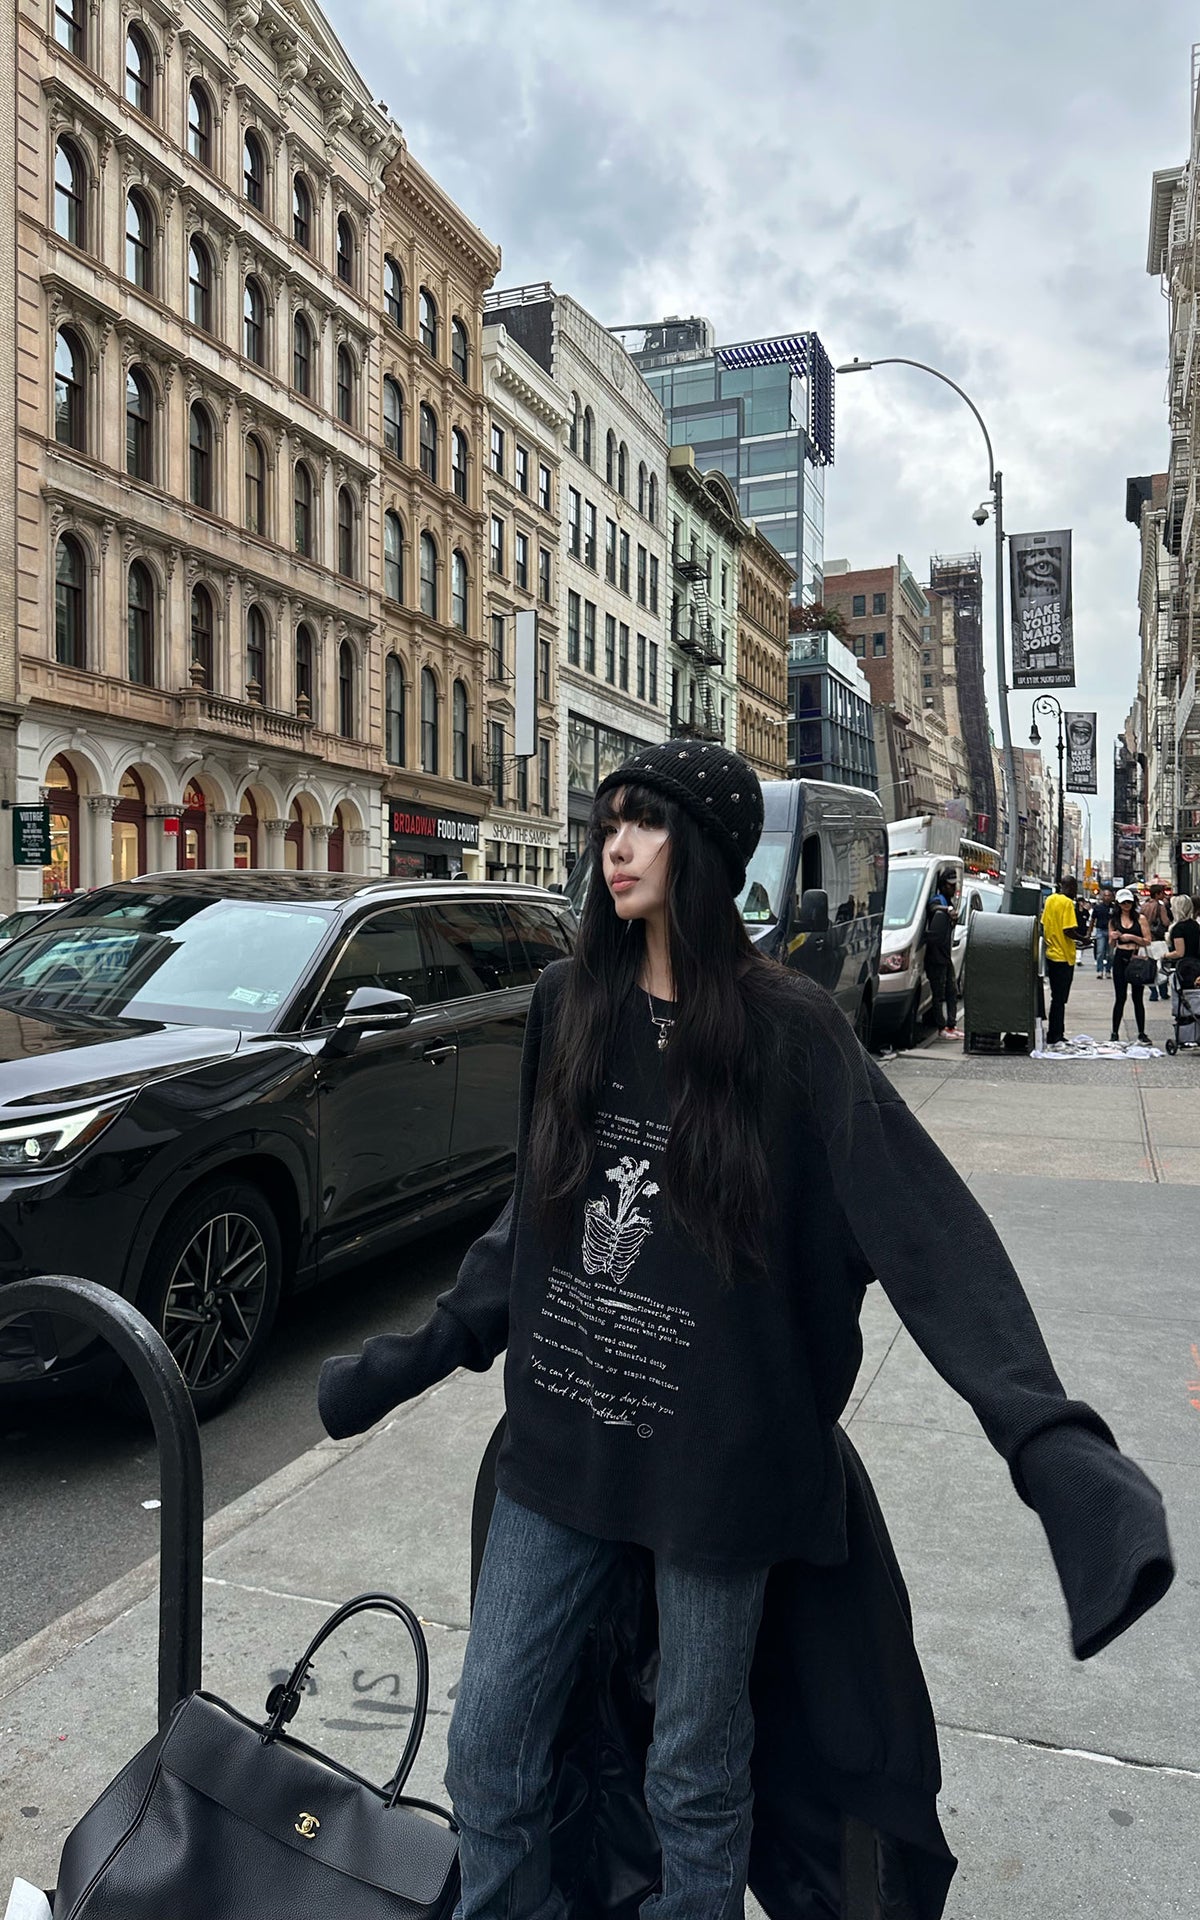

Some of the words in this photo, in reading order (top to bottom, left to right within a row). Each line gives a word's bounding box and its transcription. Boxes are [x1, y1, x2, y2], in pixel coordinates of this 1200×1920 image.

[1022, 602, 1061, 621] MAKE
[1022, 613, 1061, 631] YOUR
[1022, 622, 1062, 641] MARK
[1023, 633, 1062, 651] SOHO
[1072, 754, 1091, 762] YOUR
[393, 812, 436, 837] BROADWAY
[437, 819, 456, 840] FOOD
[457, 822, 479, 843] COURT
[493, 823, 512, 840] SHOP
[515, 827, 528, 842] THE
[529, 829, 551, 846] SAMPLE
[594, 1282, 617, 1293] spread
[619, 1289, 651, 1303] happiness
[666, 1305, 690, 1317] pollen
[597, 1306, 617, 1316] color
[620, 1314, 646, 1328] abiding
[647, 1322, 656, 1330] in
[657, 1325, 678, 1336] faith
[637, 1305, 671, 1321] flowering
[679, 1318, 696, 1328] with
[541, 1307, 554, 1318] love
[594, 1334, 617, 1346] spread
[617, 1340, 639, 1351] cheer
[613, 1322, 640, 1335] protect
[642, 1328, 658, 1339] what
[659, 1333, 673, 1343] you
[674, 1337, 691, 1348] love
[604, 1346, 613, 1354] be
[615, 1349, 648, 1364] thankful
[623, 1370, 647, 1380] simple
[534, 1378, 545, 1389] can
[547, 1382, 570, 1397] start
[619, 1391, 640, 1407] day,
[641, 1395, 657, 1409] but
[657, 1405, 674, 1416] you
